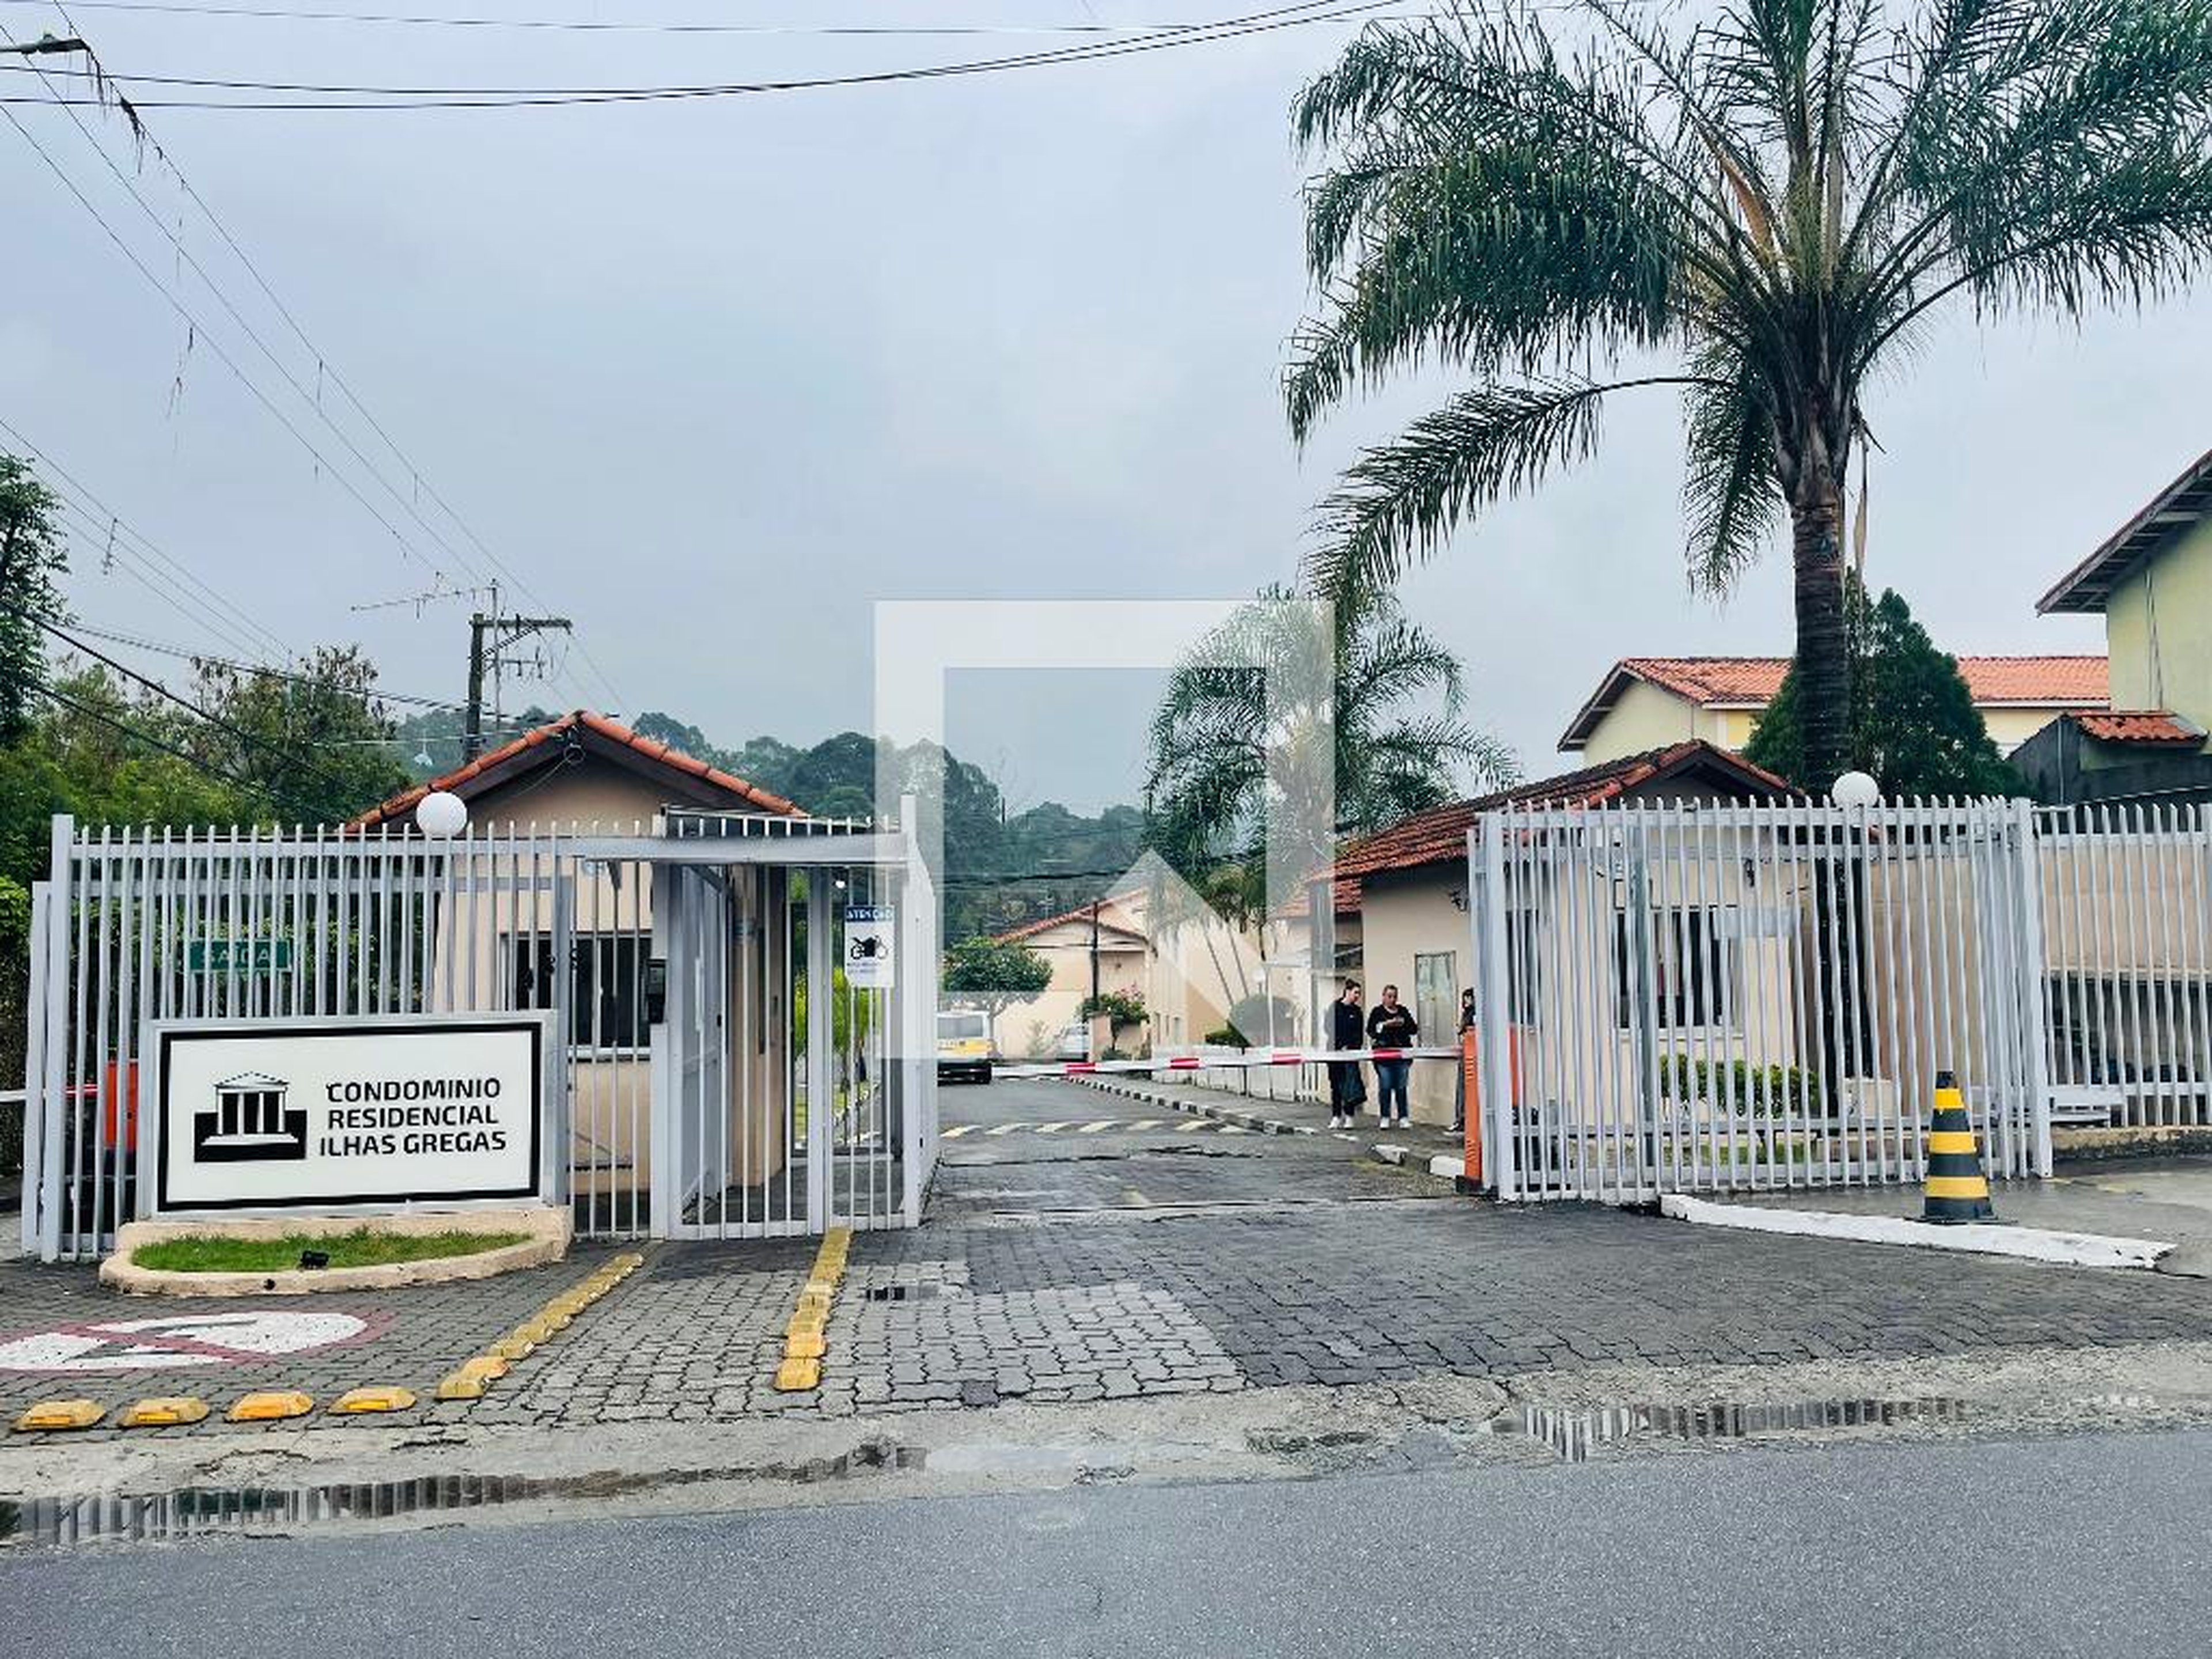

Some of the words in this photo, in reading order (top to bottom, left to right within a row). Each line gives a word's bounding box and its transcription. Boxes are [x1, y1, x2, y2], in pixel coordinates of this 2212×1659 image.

[326, 1078, 500, 1102] CONDOMINIO
[328, 1105, 499, 1129] RESIDENCIAL
[320, 1134, 396, 1156] ILHAS
[403, 1131, 506, 1154] GREGAS
